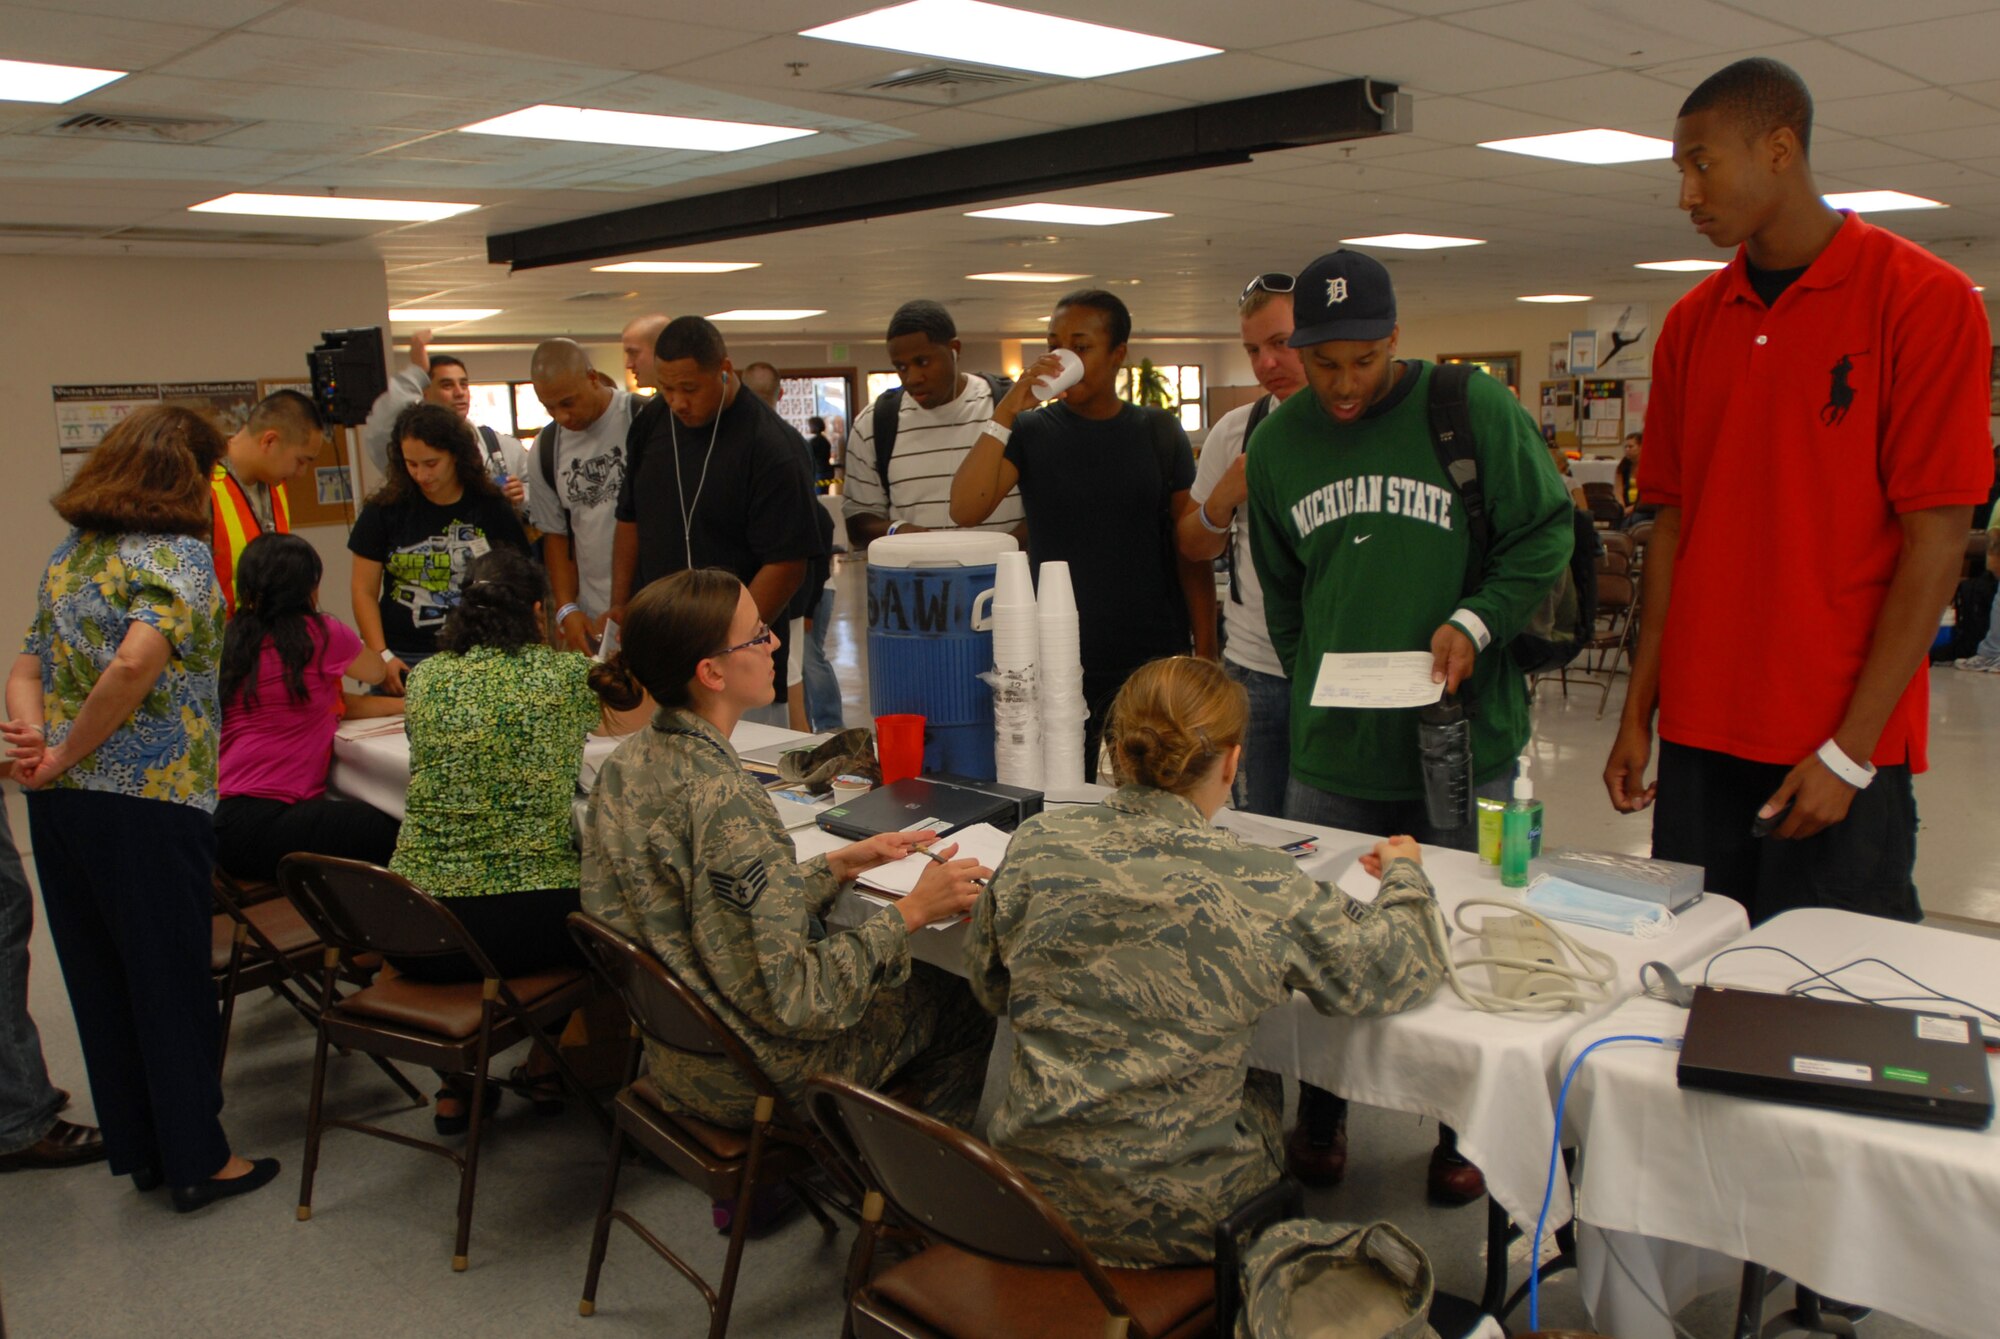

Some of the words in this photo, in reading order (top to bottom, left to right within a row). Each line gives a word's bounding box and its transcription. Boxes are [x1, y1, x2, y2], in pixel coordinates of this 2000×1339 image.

[1326, 277, 1348, 307] D
[54, 386, 93, 396] Victory
[96, 385, 134, 395] Martial
[136, 385, 157, 394] Arts
[161, 384, 198, 395] Victory
[198, 383, 233, 393] Martial
[235, 382, 256, 391] Arts
[1291, 475, 1383, 538] MICHIGAN
[1387, 476, 1452, 530] STATE
